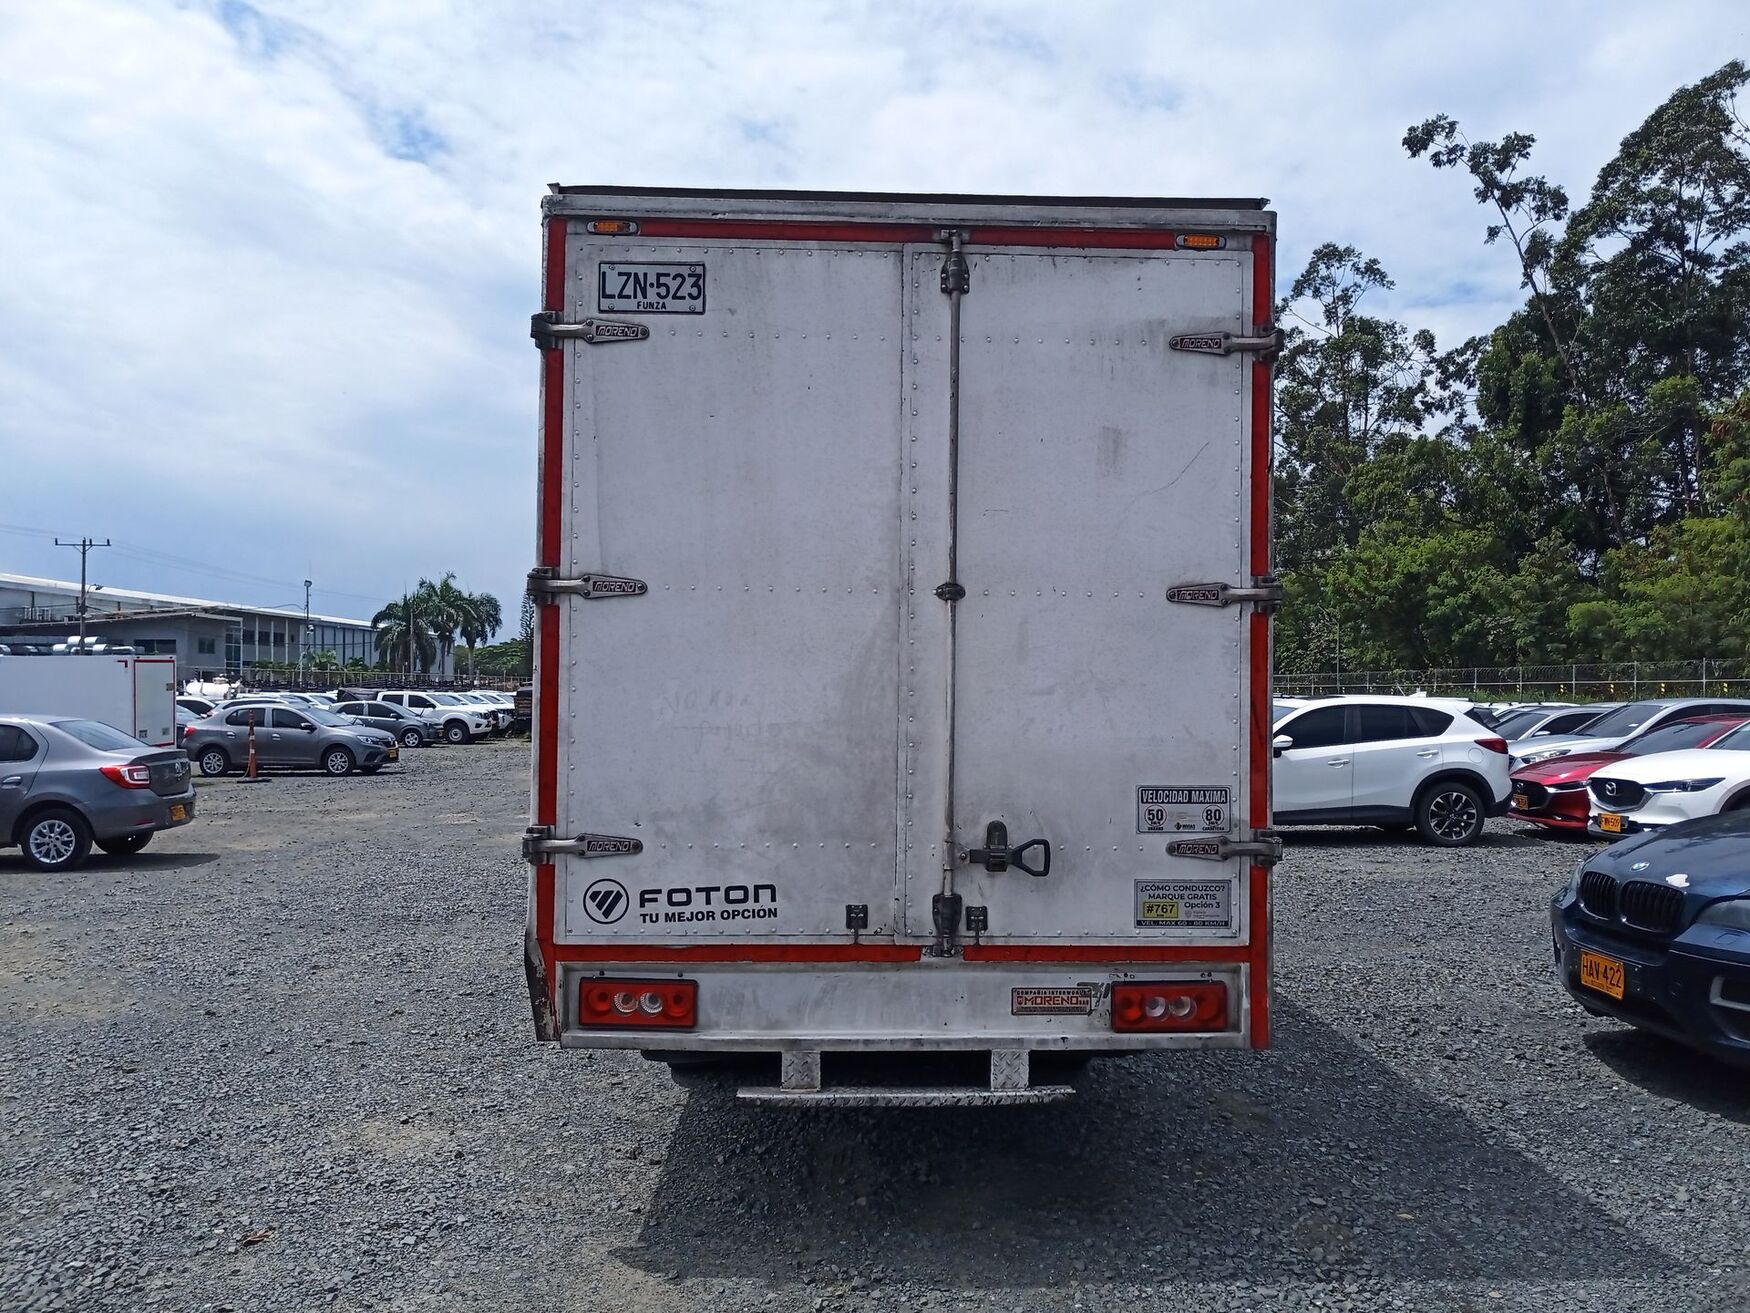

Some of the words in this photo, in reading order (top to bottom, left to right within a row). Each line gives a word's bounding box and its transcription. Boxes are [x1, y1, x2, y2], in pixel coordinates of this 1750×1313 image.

[636, 301, 667, 310] FUNZA
[597, 326, 638, 337] MORENO
[1181, 338, 1221, 349] MORENO
[594, 581, 635, 592] MORENO
[1178, 590, 1218, 600] MORENO
[1142, 789, 1189, 803] VELOCIDAD
[1191, 789, 1227, 803] MAXIMA
[1147, 808, 1164, 822] 50
[1205, 808, 1222, 822] 80
[589, 841, 630, 851] MORENO
[1178, 844, 1218, 854] MORENO
[1173, 884, 1226, 892] CONDUZCO?
[639, 884, 777, 908] FOTON
[1148, 893, 1185, 901] MARQUE
[1146, 904, 1176, 914] #767
[1184, 901, 1214, 909] Opción
[640, 913, 659, 923] TU
[664, 910, 716, 923] MEJOR
[720, 905, 778, 920] OPCIÓN
[1603, 965, 1622, 988] 422
[1024, 995, 1079, 1005] MORENO
